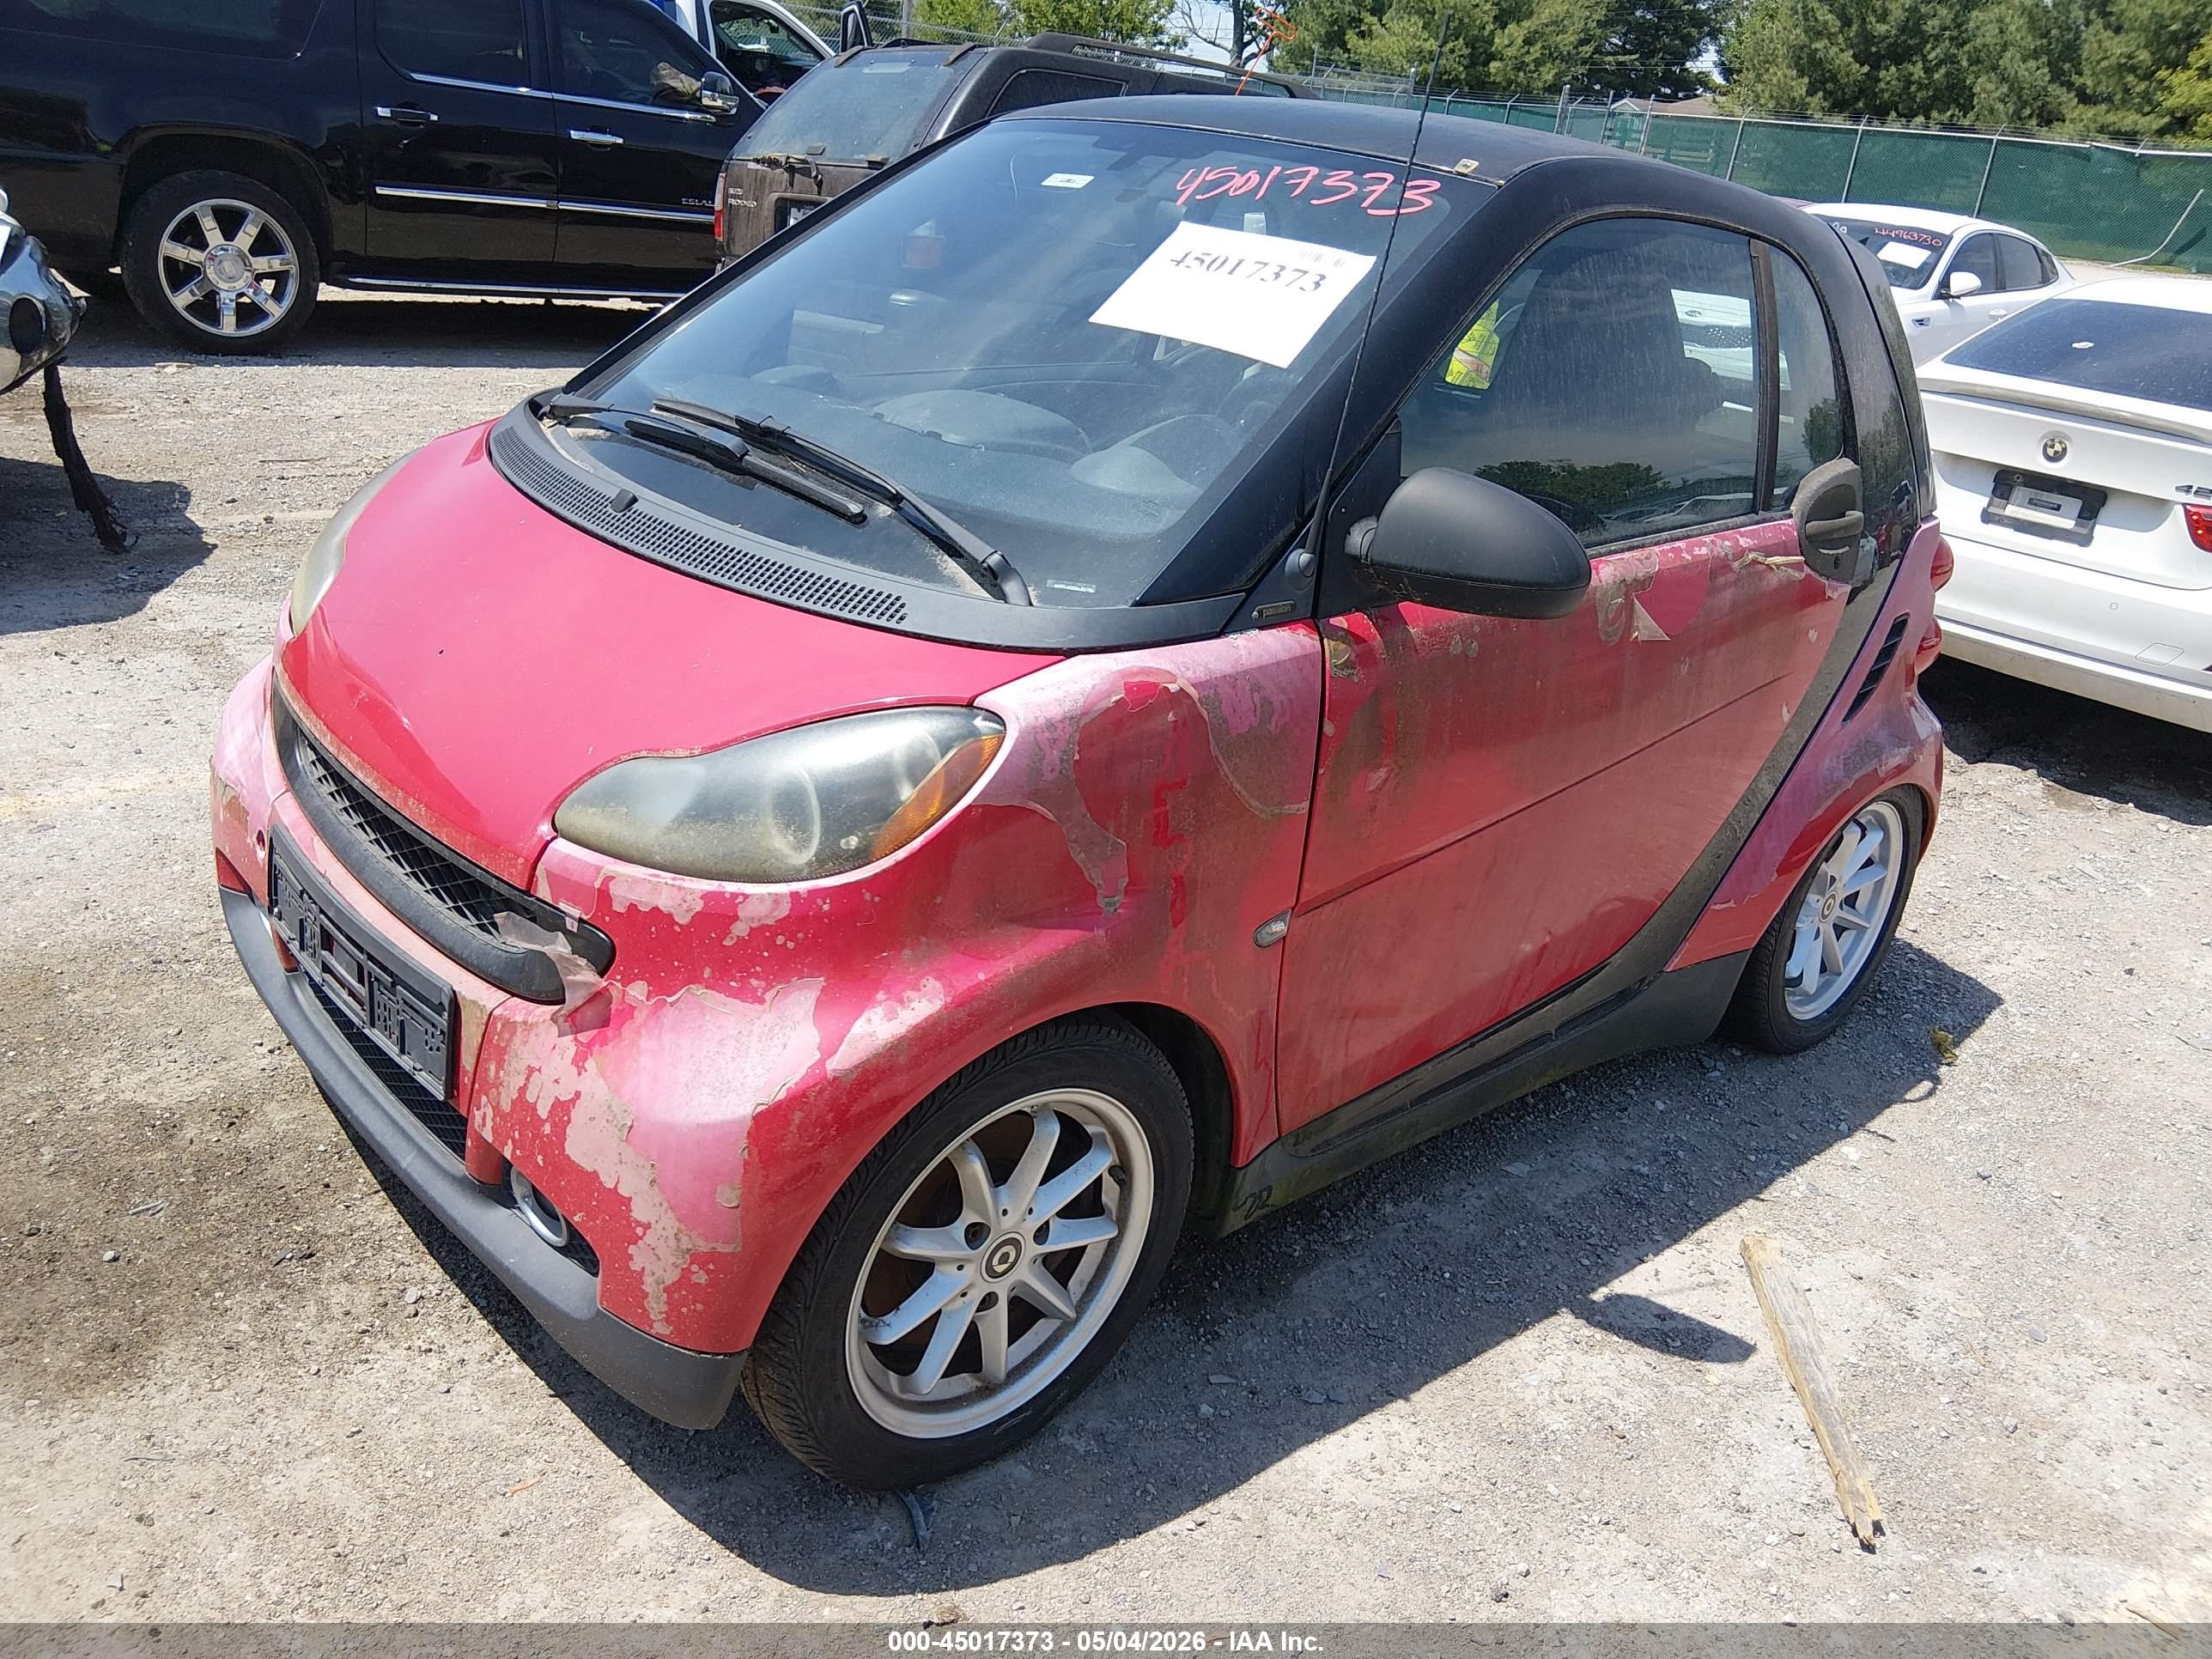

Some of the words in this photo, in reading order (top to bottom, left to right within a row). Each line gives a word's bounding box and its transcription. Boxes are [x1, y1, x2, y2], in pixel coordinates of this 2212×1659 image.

[727, 198, 757, 208] RODEO
[1176, 166, 1442, 216] 45017373
[1875, 227, 1942, 247] 44963730
[1170, 250, 1327, 293] 45017373
